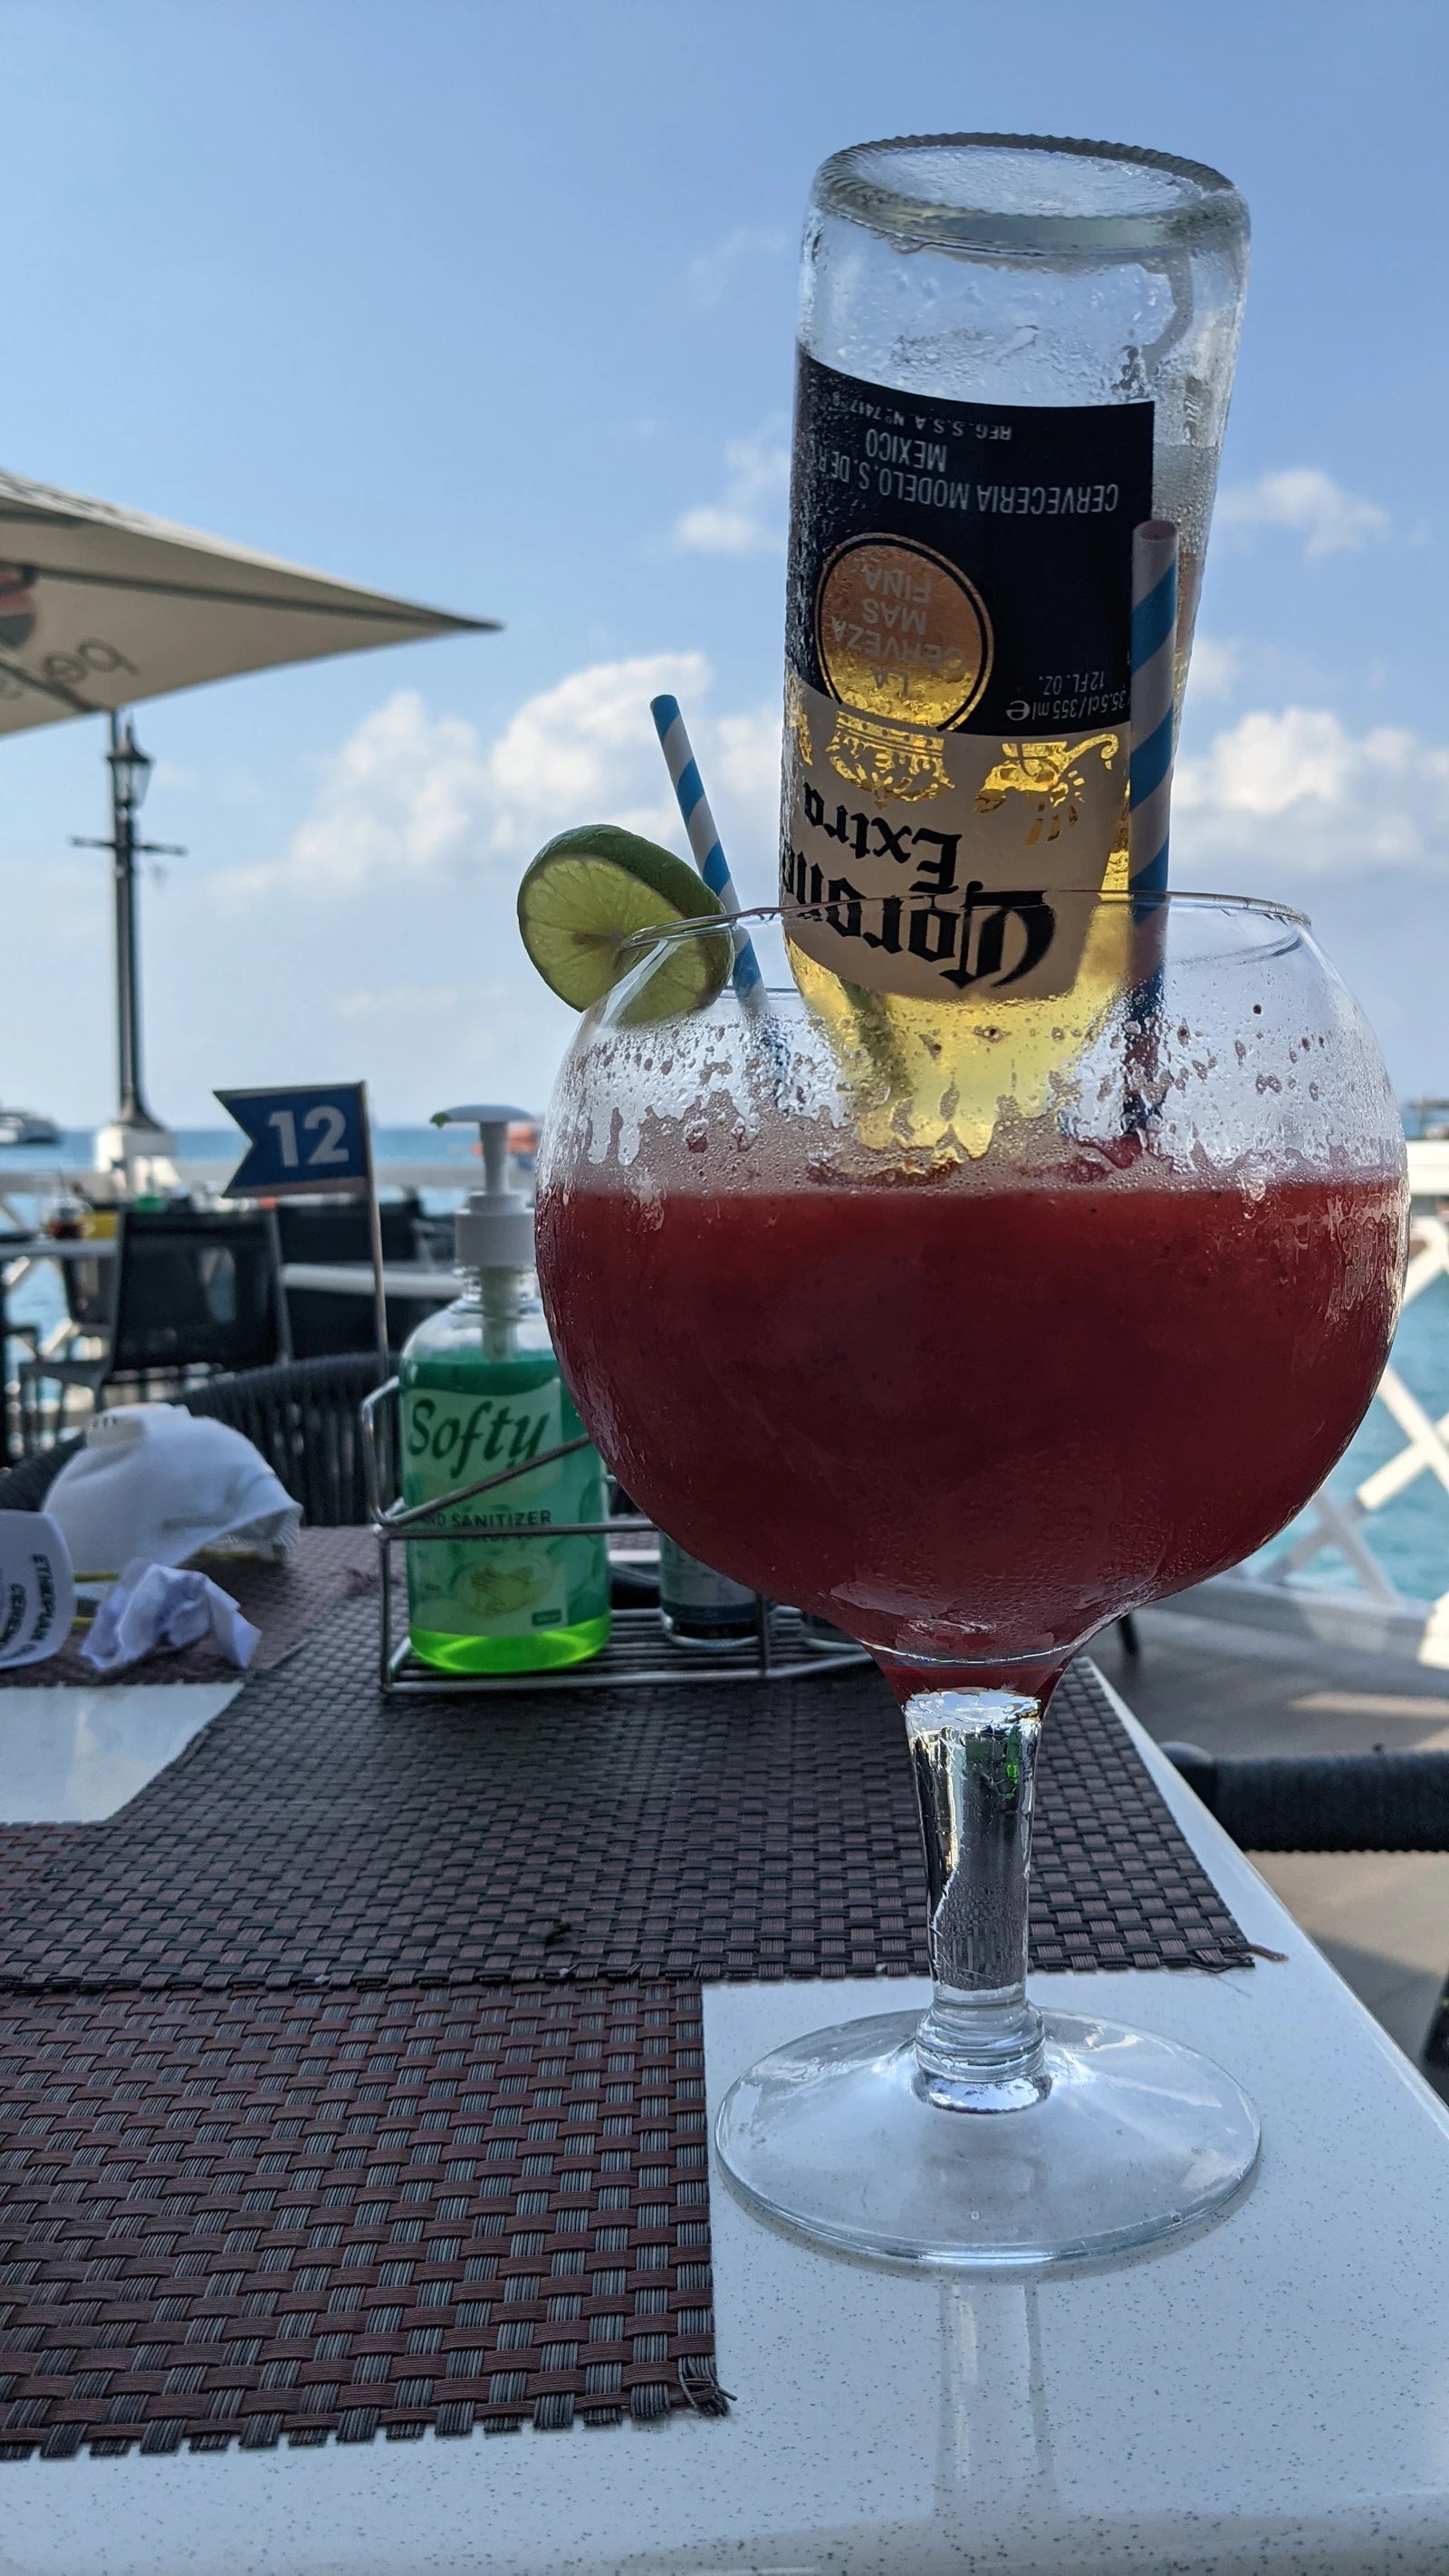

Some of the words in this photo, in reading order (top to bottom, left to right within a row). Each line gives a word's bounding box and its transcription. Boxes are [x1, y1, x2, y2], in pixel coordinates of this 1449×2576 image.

[865, 428, 947, 473] MEXICO
[976, 483, 1119, 515] CERVECERIA
[862, 562, 932, 604] FINA
[861, 597, 927, 636] MAS
[830, 616, 965, 683] CERVEZA
[803, 782, 964, 896] Extra
[268, 1105, 350, 1168] 12
[409, 1398, 550, 1479] Softy
[452, 1509, 552, 1528] SANITIZER
